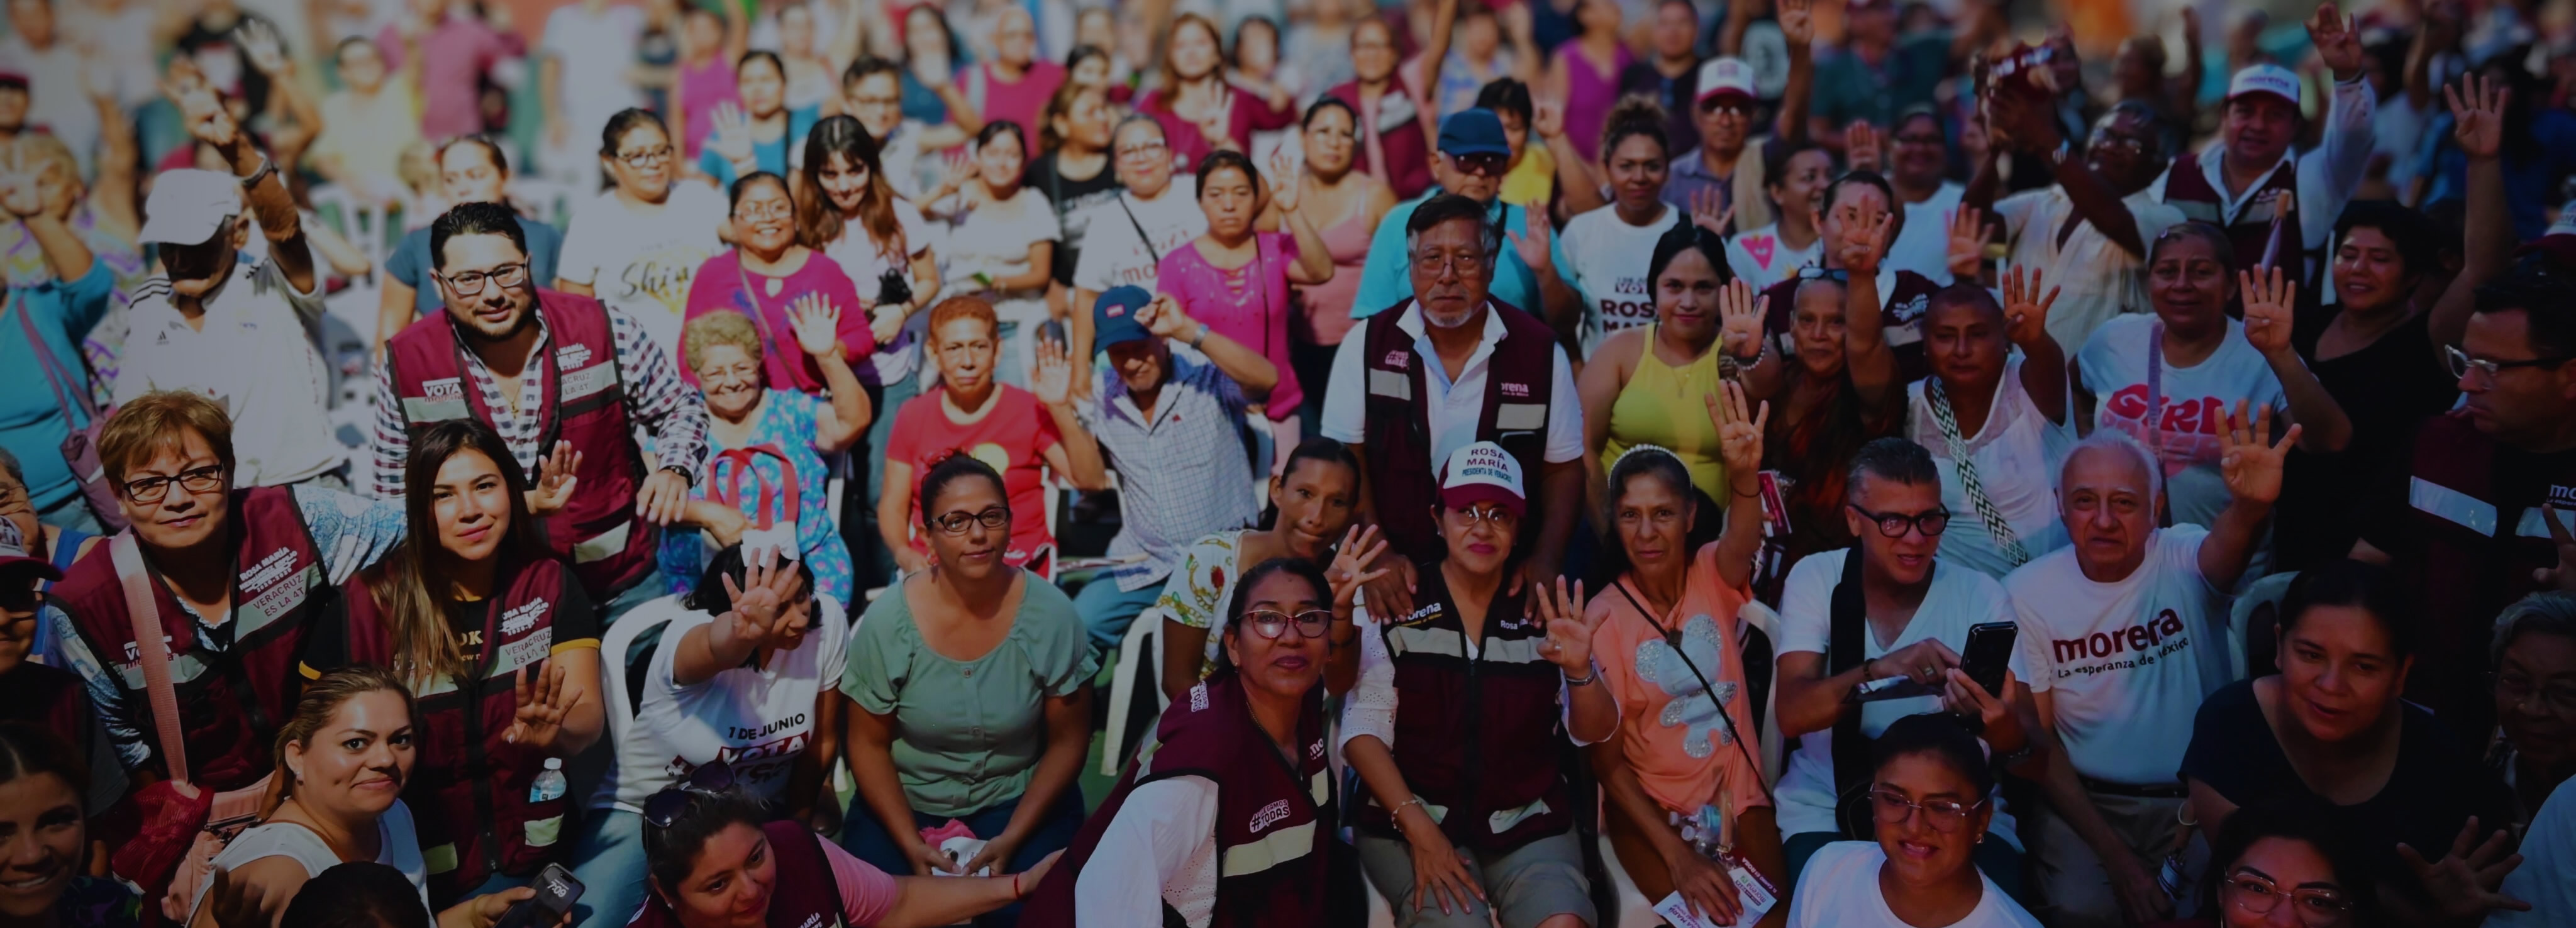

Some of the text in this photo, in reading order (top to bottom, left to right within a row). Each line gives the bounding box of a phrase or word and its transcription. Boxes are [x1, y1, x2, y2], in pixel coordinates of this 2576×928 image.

[1601, 299, 1656, 318] ROS
[423, 382, 464, 398] VOTA
[1467, 458, 1508, 473] MARÍA
[1471, 448, 1505, 461] ROSA
[239, 563, 262, 582] ROSA
[261, 546, 291, 567] MARÍA
[253, 574, 304, 609] VERACRUZ
[264, 587, 304, 617] ES LA 4T
[501, 607, 519, 621] OSA
[1407, 602, 1442, 621] orena
[1500, 619, 1518, 630] Rosa
[505, 630, 553, 656] VERACRUZ
[513, 655, 526, 665] ES
[540, 642, 550, 653] 4T
[2058, 668, 2071, 678] La
[2139, 653, 2155, 666] de
[729, 713, 806, 740] 1 DE JUNIO
[722, 734, 806, 766] VOTA
